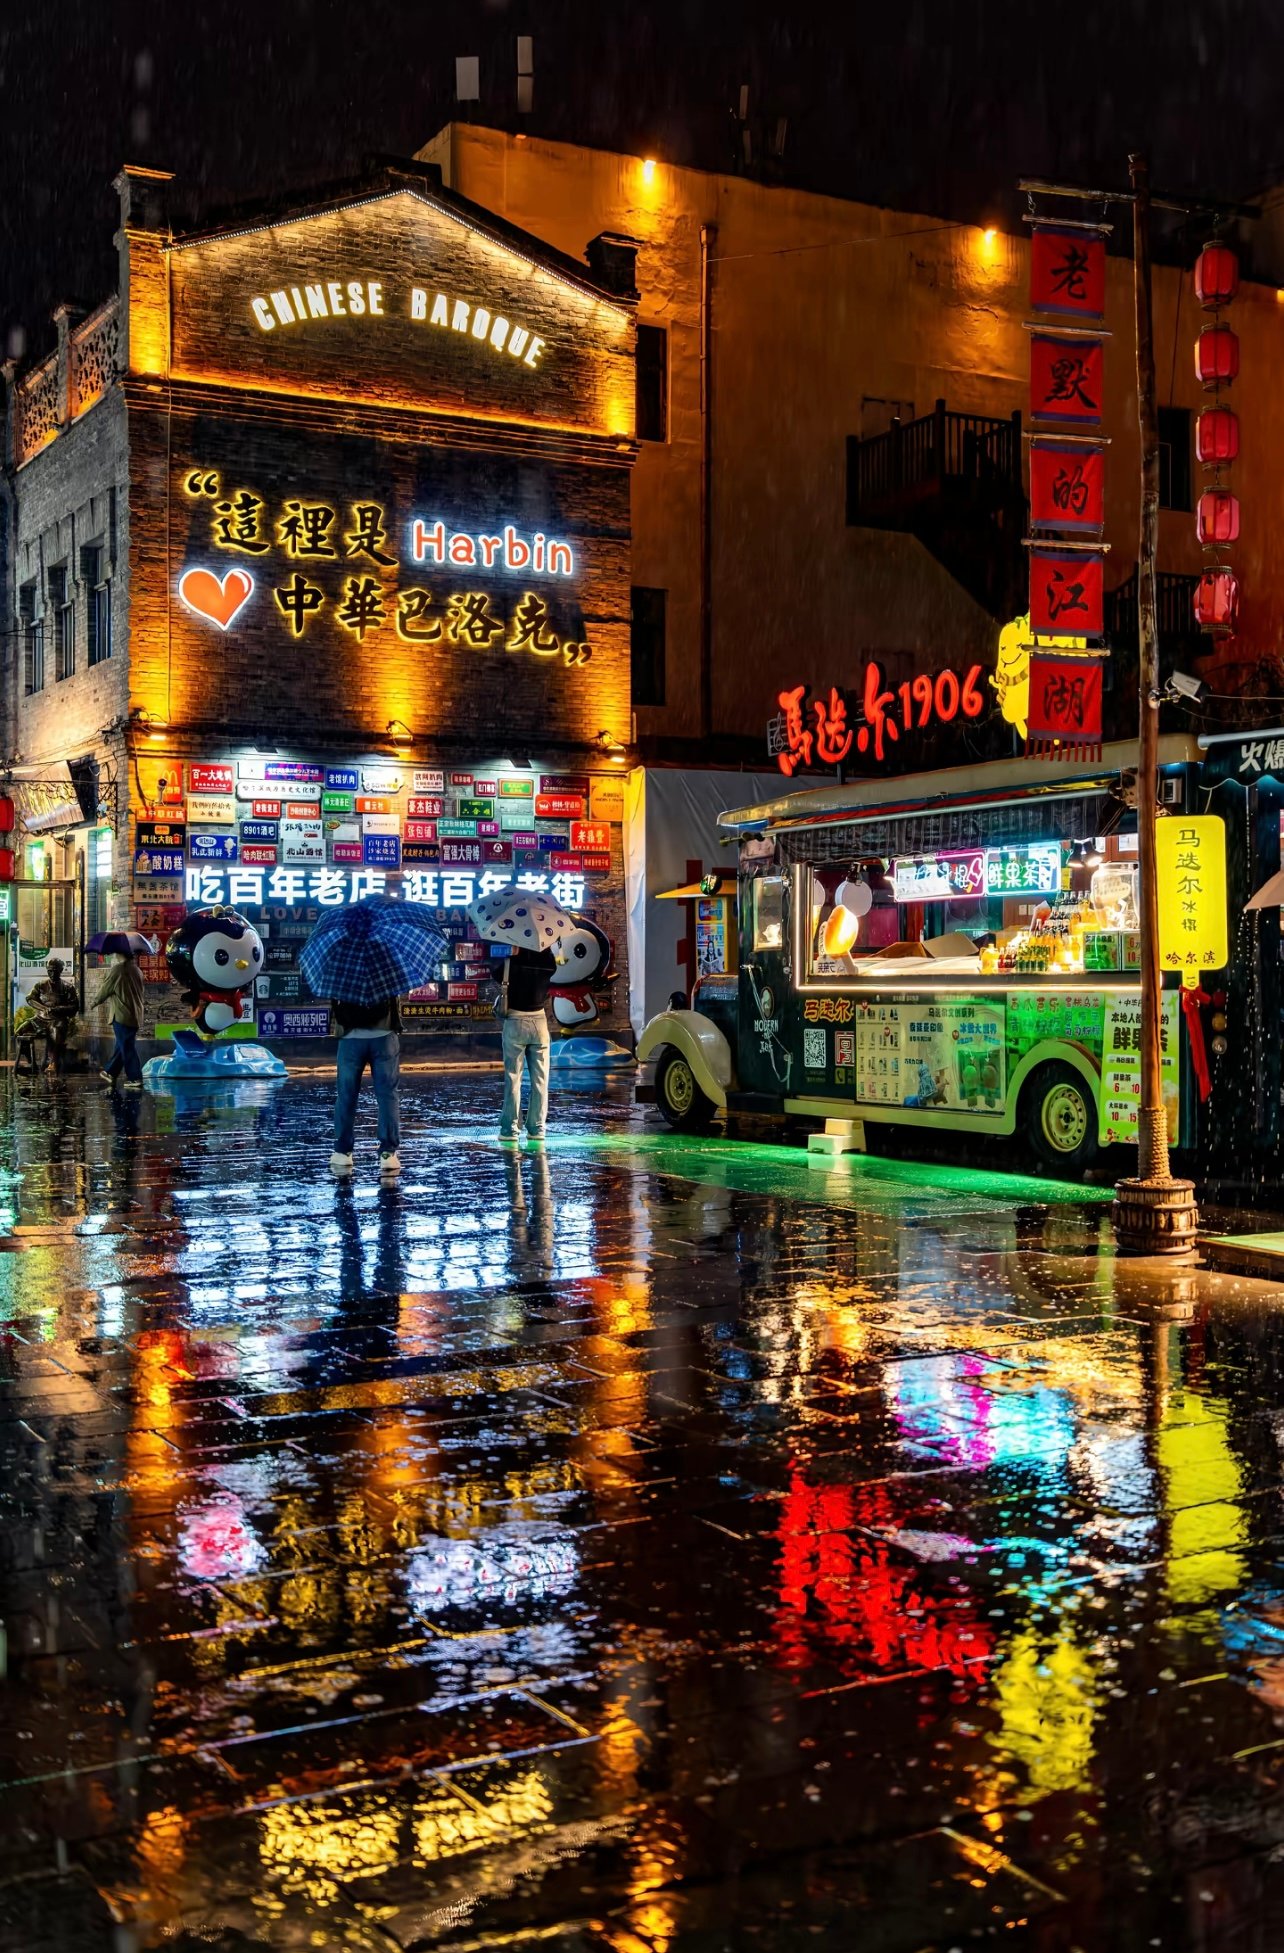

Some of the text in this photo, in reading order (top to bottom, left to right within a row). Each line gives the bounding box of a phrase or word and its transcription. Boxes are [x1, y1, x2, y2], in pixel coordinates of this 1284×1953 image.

[252, 282, 546, 368] CHINESE BAROQUE
[412, 519, 573, 575] Harbin
[408, 800, 441, 814] 豪杰鞋业
[243, 825, 275, 836] 8901酒吧
[407, 825, 433, 838] 张包铺
[443, 844, 480, 862] 富强大骨棒
[152, 855, 184, 871] 酸奶糕
[988, 864, 1038, 888] 鲜果茶
[1175, 829, 1203, 931] 马迭尔冰棍
[261, 907, 318, 919] LOVE
[1165, 950, 1216, 965] 哈尔滨
